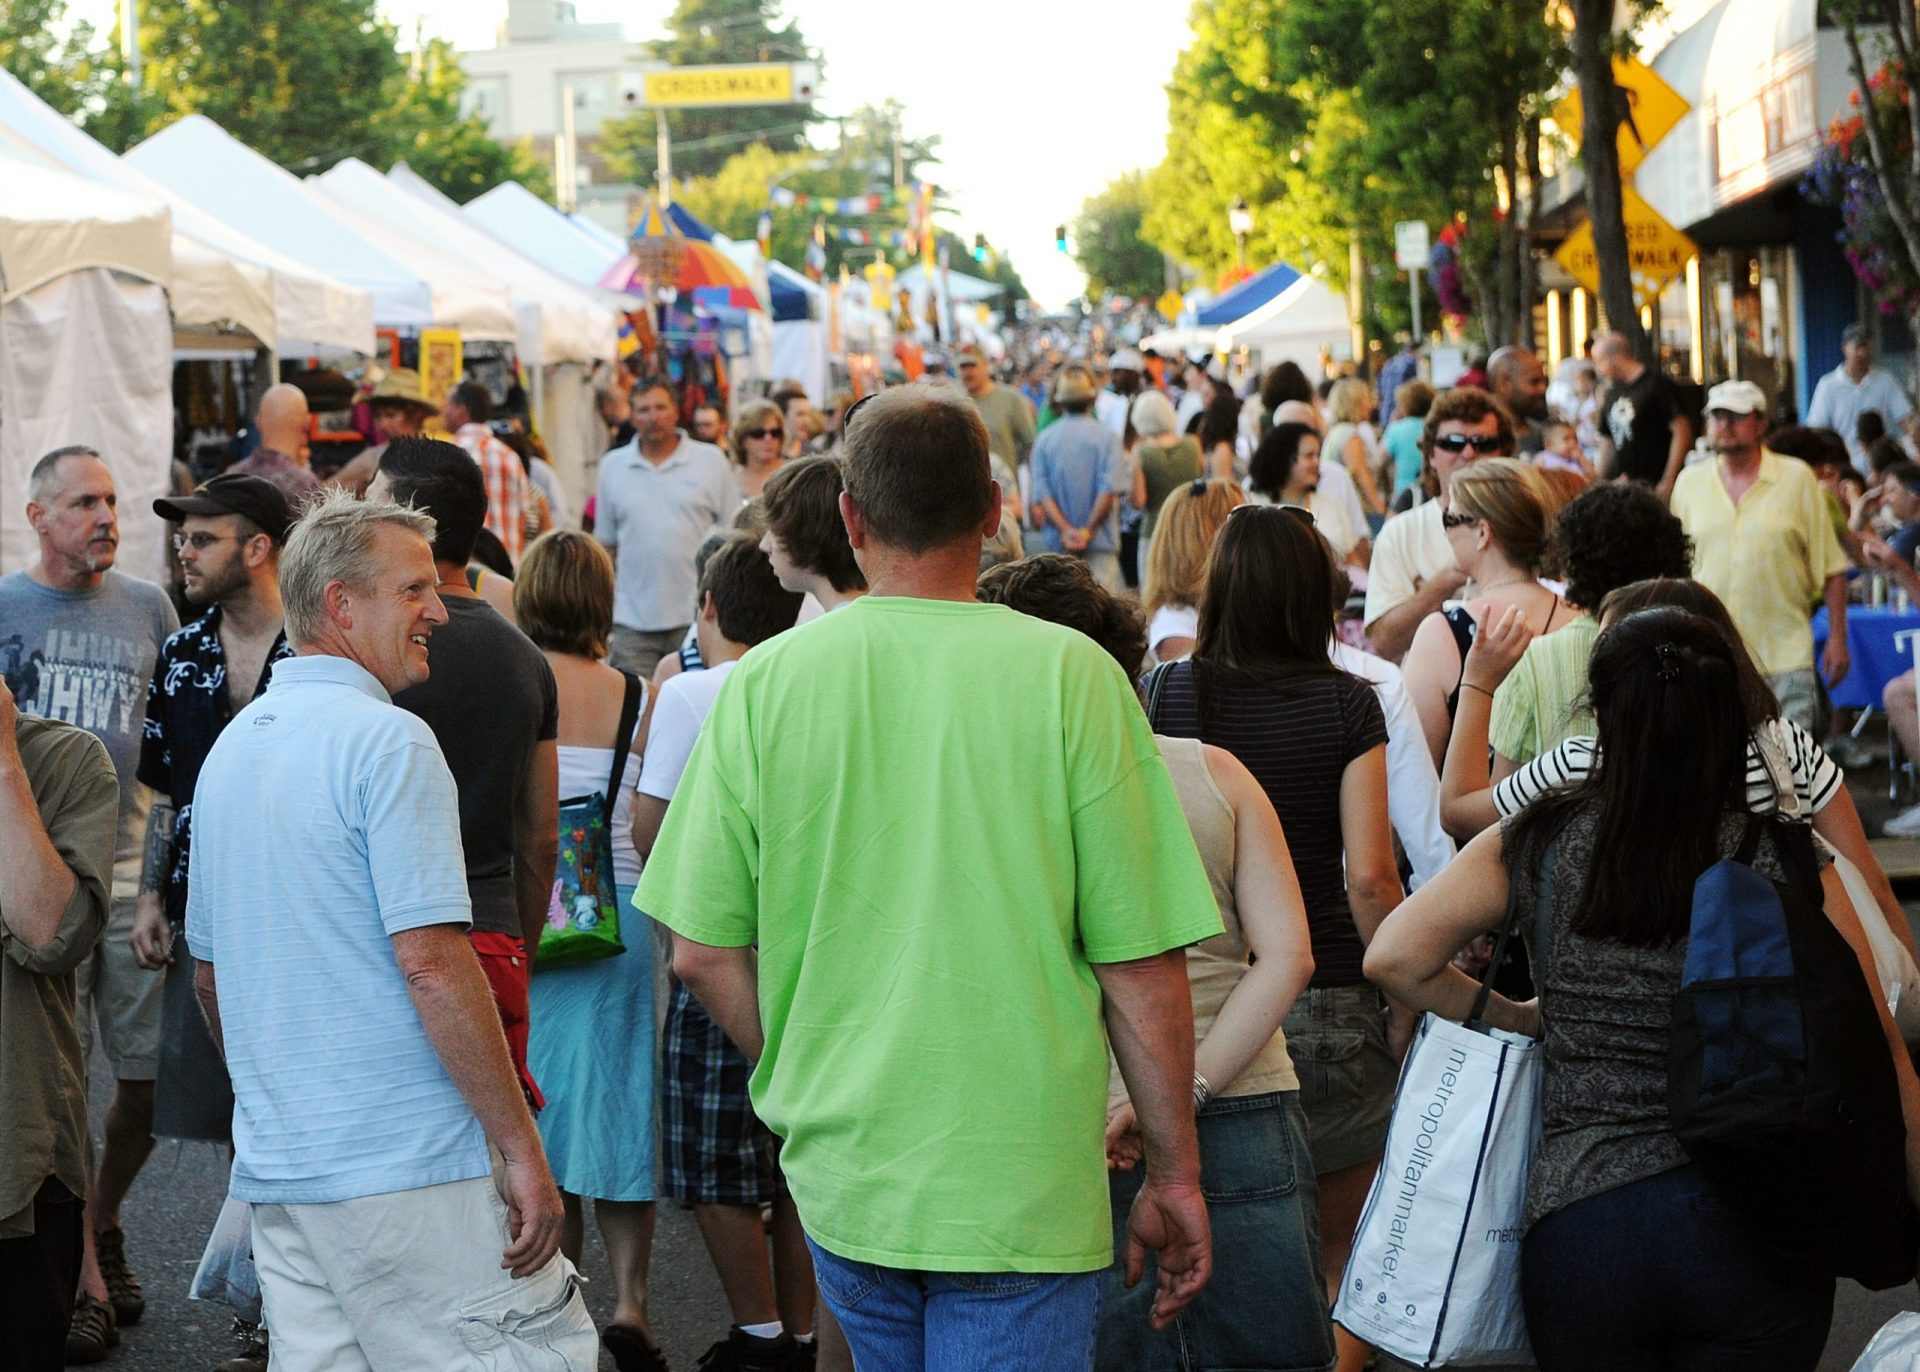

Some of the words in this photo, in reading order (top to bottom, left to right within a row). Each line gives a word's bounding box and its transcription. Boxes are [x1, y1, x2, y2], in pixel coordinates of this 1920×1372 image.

[654, 75, 779, 98] CROSSWALK
[1570, 249, 1679, 269] CRWALK
[48, 663, 140, 686] WYOMING
[26, 673, 142, 734] JHWY
[1381, 1048, 1467, 1280] metropolitanmarket
